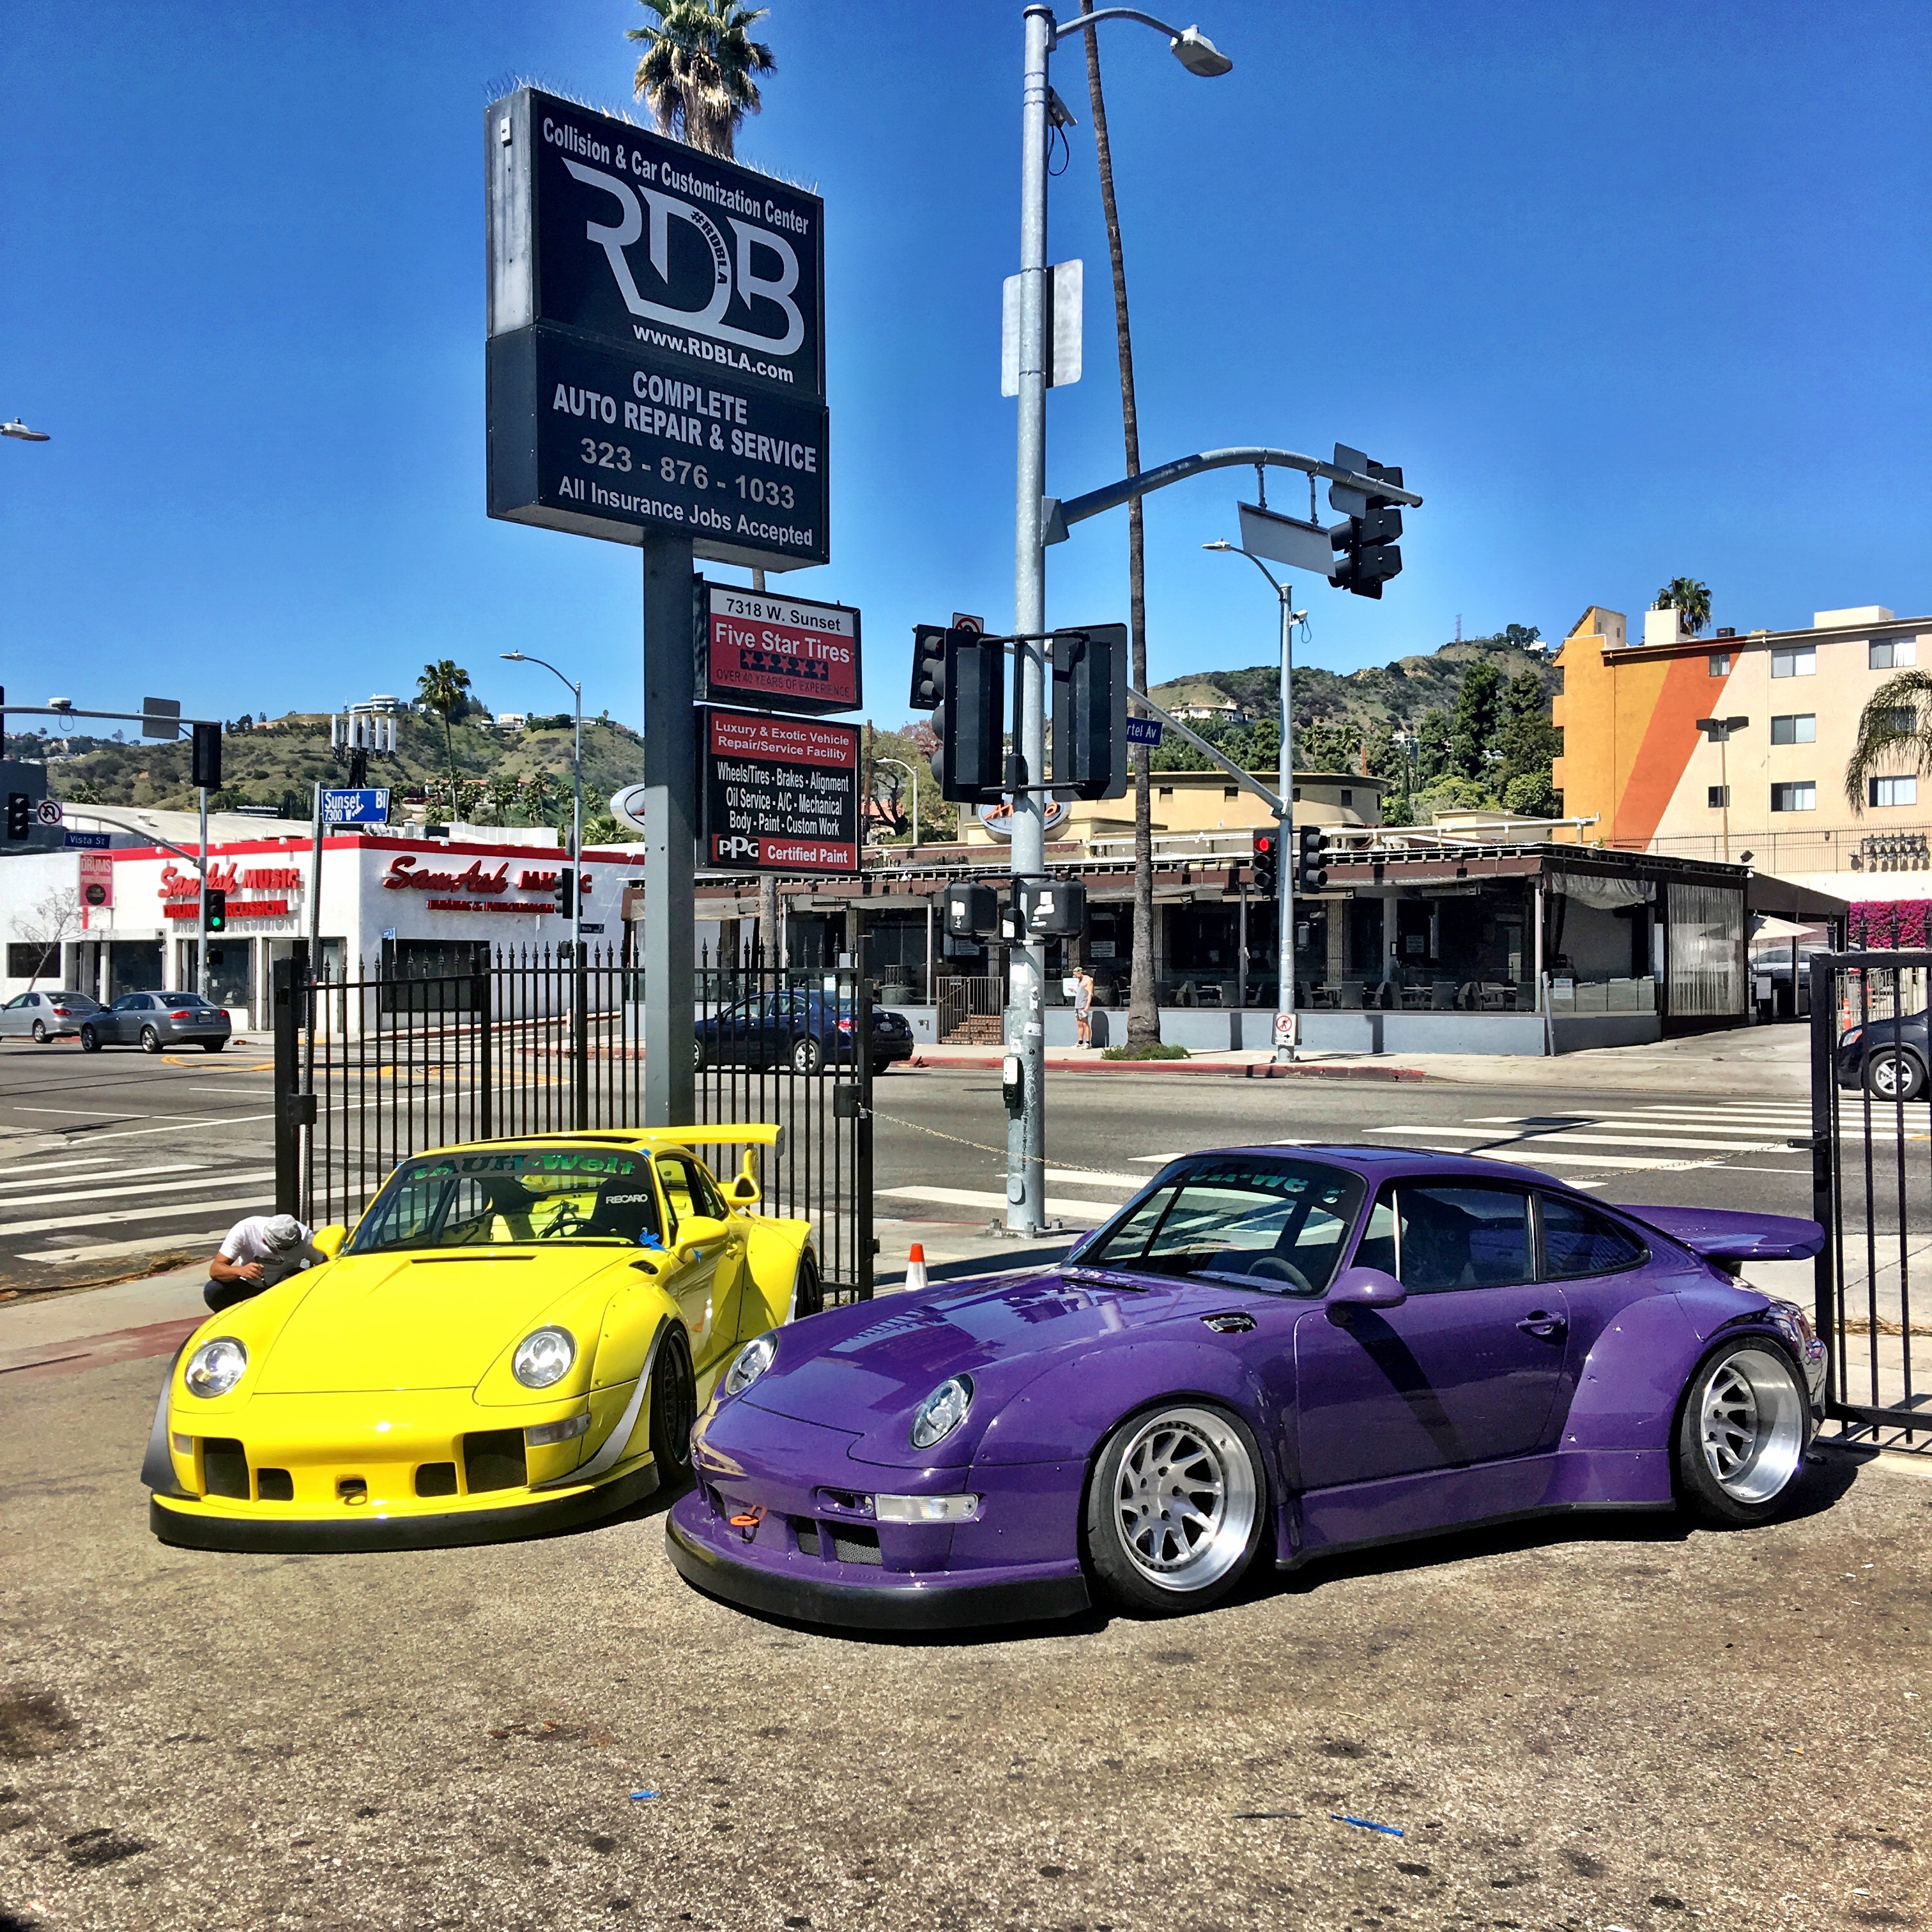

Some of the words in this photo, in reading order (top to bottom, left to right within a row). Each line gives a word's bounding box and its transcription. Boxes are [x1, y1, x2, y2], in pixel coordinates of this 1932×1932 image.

[544, 117, 610, 164] Collision
[616, 144, 626, 169] &
[631, 151, 657, 181] Car
[661, 162, 760, 218] Customization
[765, 201, 808, 235] Center
[562, 158, 805, 356] RDB
[691, 210, 727, 284] #RDBLA
[633, 325, 793, 383] www.RDBLA.com
[633, 371, 747, 425] COMPLETE
[553, 383, 617, 424] AUTO
[625, 402, 702, 447] REPAIR
[710, 424, 723, 451] &
[732, 429, 816, 473] SERVICE
[581, 438, 632, 472] 323
[661, 457, 709, 490] 876
[735, 475, 795, 509] 1033
[559, 476, 585, 500] All
[592, 482, 683, 521] Insurance
[689, 505, 731, 531] Jobs
[737, 515, 813, 546] Accepted
[726, 598, 761, 617] 7318
[767, 606, 785, 621] W.
[790, 610, 841, 631] Sunset
[716, 622, 755, 647] Five
[762, 631, 799, 654] Star
[805, 638, 850, 663] Tires
[717, 669, 740, 682] OVER
[755, 675, 783, 687] YEARS
[786, 679, 797, 689] OF
[799, 682, 850, 697] EXPERIENCE
[716, 721, 756, 737] Luxury
[760, 726, 768, 736] &
[772, 728, 806, 740] Exotic
[810, 732, 849, 746] Vehicle
[1127, 724, 1143, 737] rtel
[1146, 726, 1156, 738] Av
[718, 736, 803, 755] Repair/Service
[807, 746, 847, 761] Facility
[717, 762, 769, 785] Wheels/Tires
[777, 768, 804, 788] Brakes
[810, 772, 849, 795] Alignment
[325, 792, 360, 809] Sunset
[376, 791, 386, 808] Bl
[325, 809, 342, 821] 7300
[346, 809, 351, 820] W
[726, 786, 738, 807] Oil
[740, 788, 770, 810] Service
[778, 792, 792, 811] A/C
[799, 793, 842, 815] Mechanical
[730, 811, 751, 834] Body
[759, 813, 779, 832] Paint
[786, 816, 817, 834] Custom
[819, 817, 839, 836] Work
[70, 836, 91, 844] Vista
[768, 845, 816, 862] Certified
[820, 850, 847, 863] Paint
[81, 858, 111, 872] DRUMS
[383, 855, 452, 891] Sam
[450, 859, 509, 894] Ash
[518, 870, 592, 893] MUC
[158, 866, 200, 898] Sam
[243, 868, 300, 889] MUSIC
[226, 900, 288, 918] RCUSSION
[606, 1193, 648, 1204] RECARO
